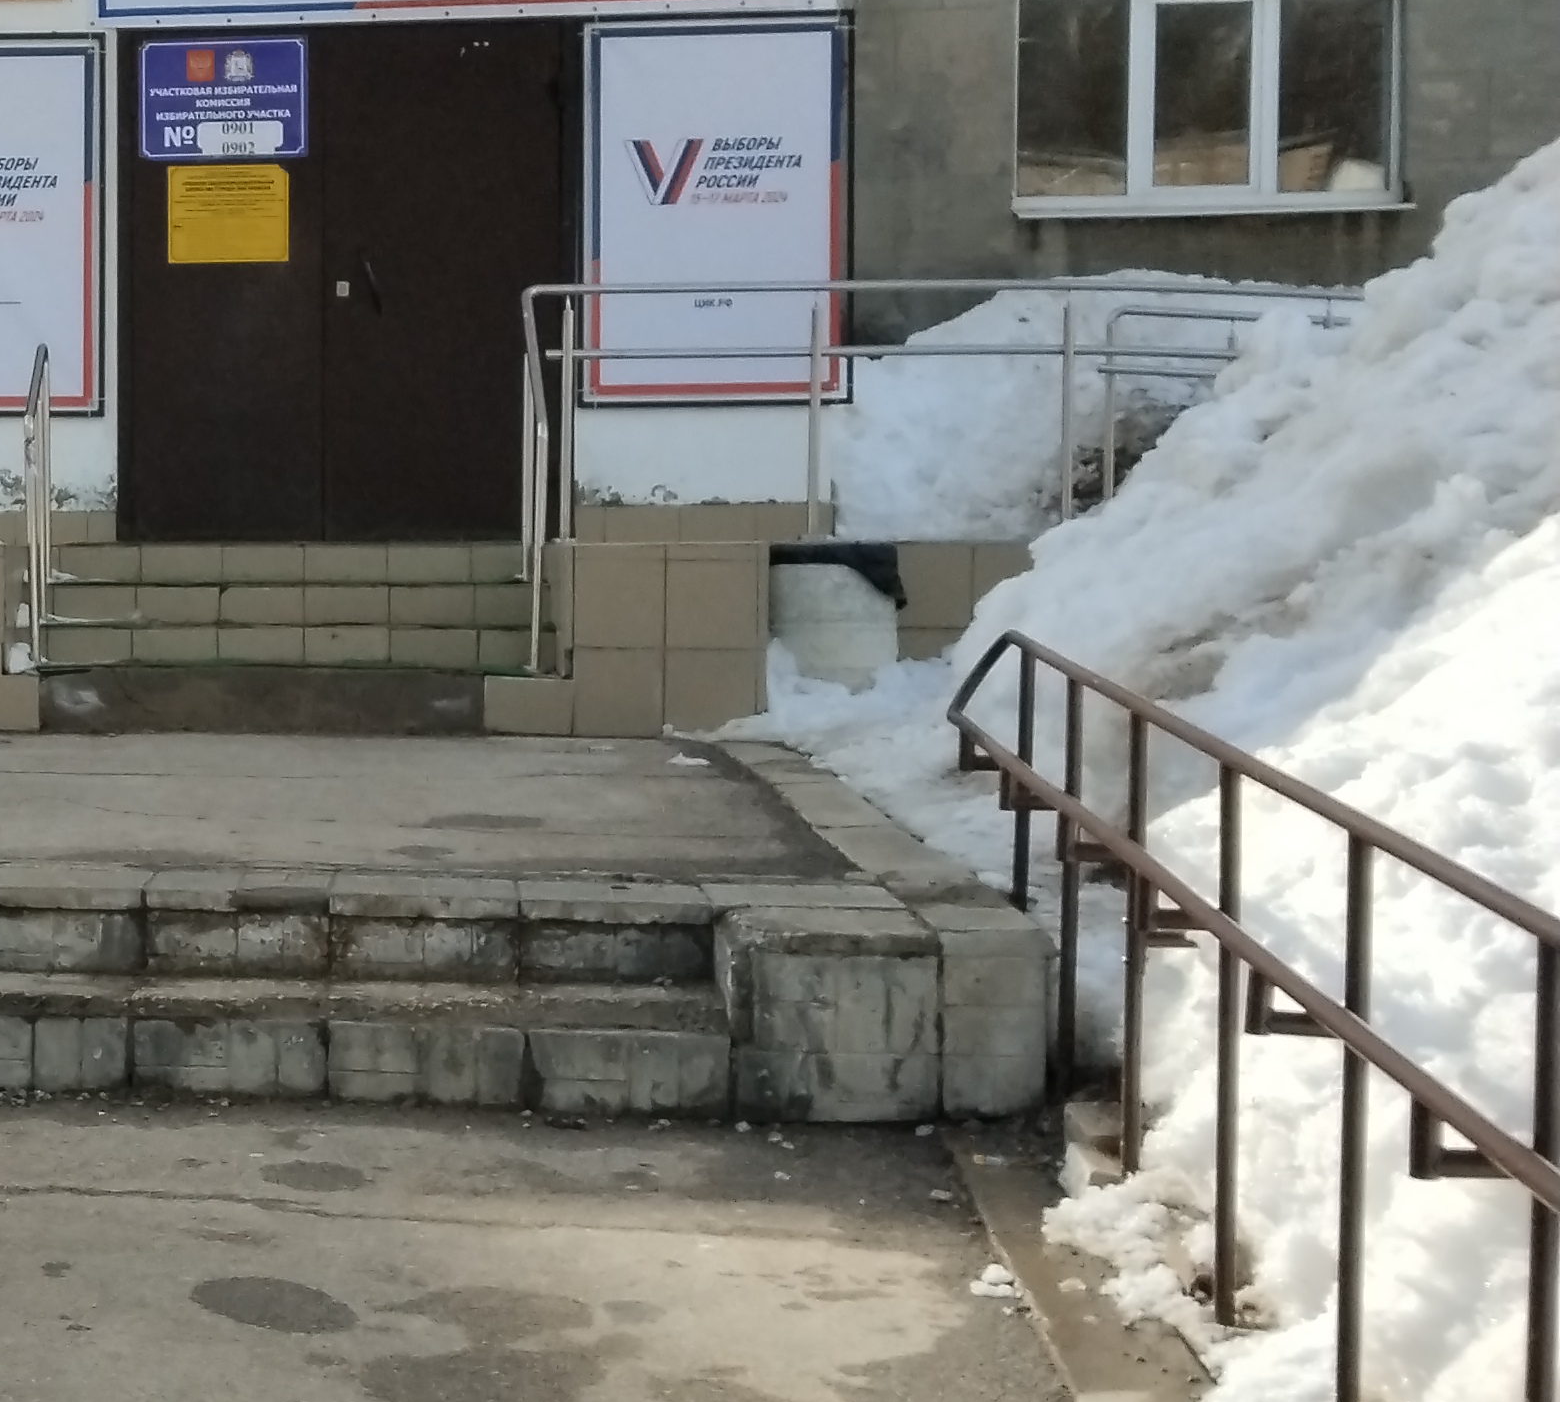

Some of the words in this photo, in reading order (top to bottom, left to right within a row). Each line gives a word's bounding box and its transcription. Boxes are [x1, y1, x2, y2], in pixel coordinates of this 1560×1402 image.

[149, 86, 213, 97] УЧАСТКОВАЯ
[214, 84, 298, 95] ИЗБИРАТЕЛЬНАЯ
[195, 98, 251, 108] КОМИССИЯ
[155, 111, 246, 121] ИЗБИРАТЕЛЬНОГО
[246, 109, 292, 118] УЧАСТКА
[163, 125, 195, 148] №
[221, 121, 255, 135] 0901
[221, 142, 255, 154] 0902
[711, 136, 783, 152] ВЫБОРЫ
[703, 154, 803, 170] ПРЕЗИДЕНТА
[695, 173, 760, 188] РОССИИ
